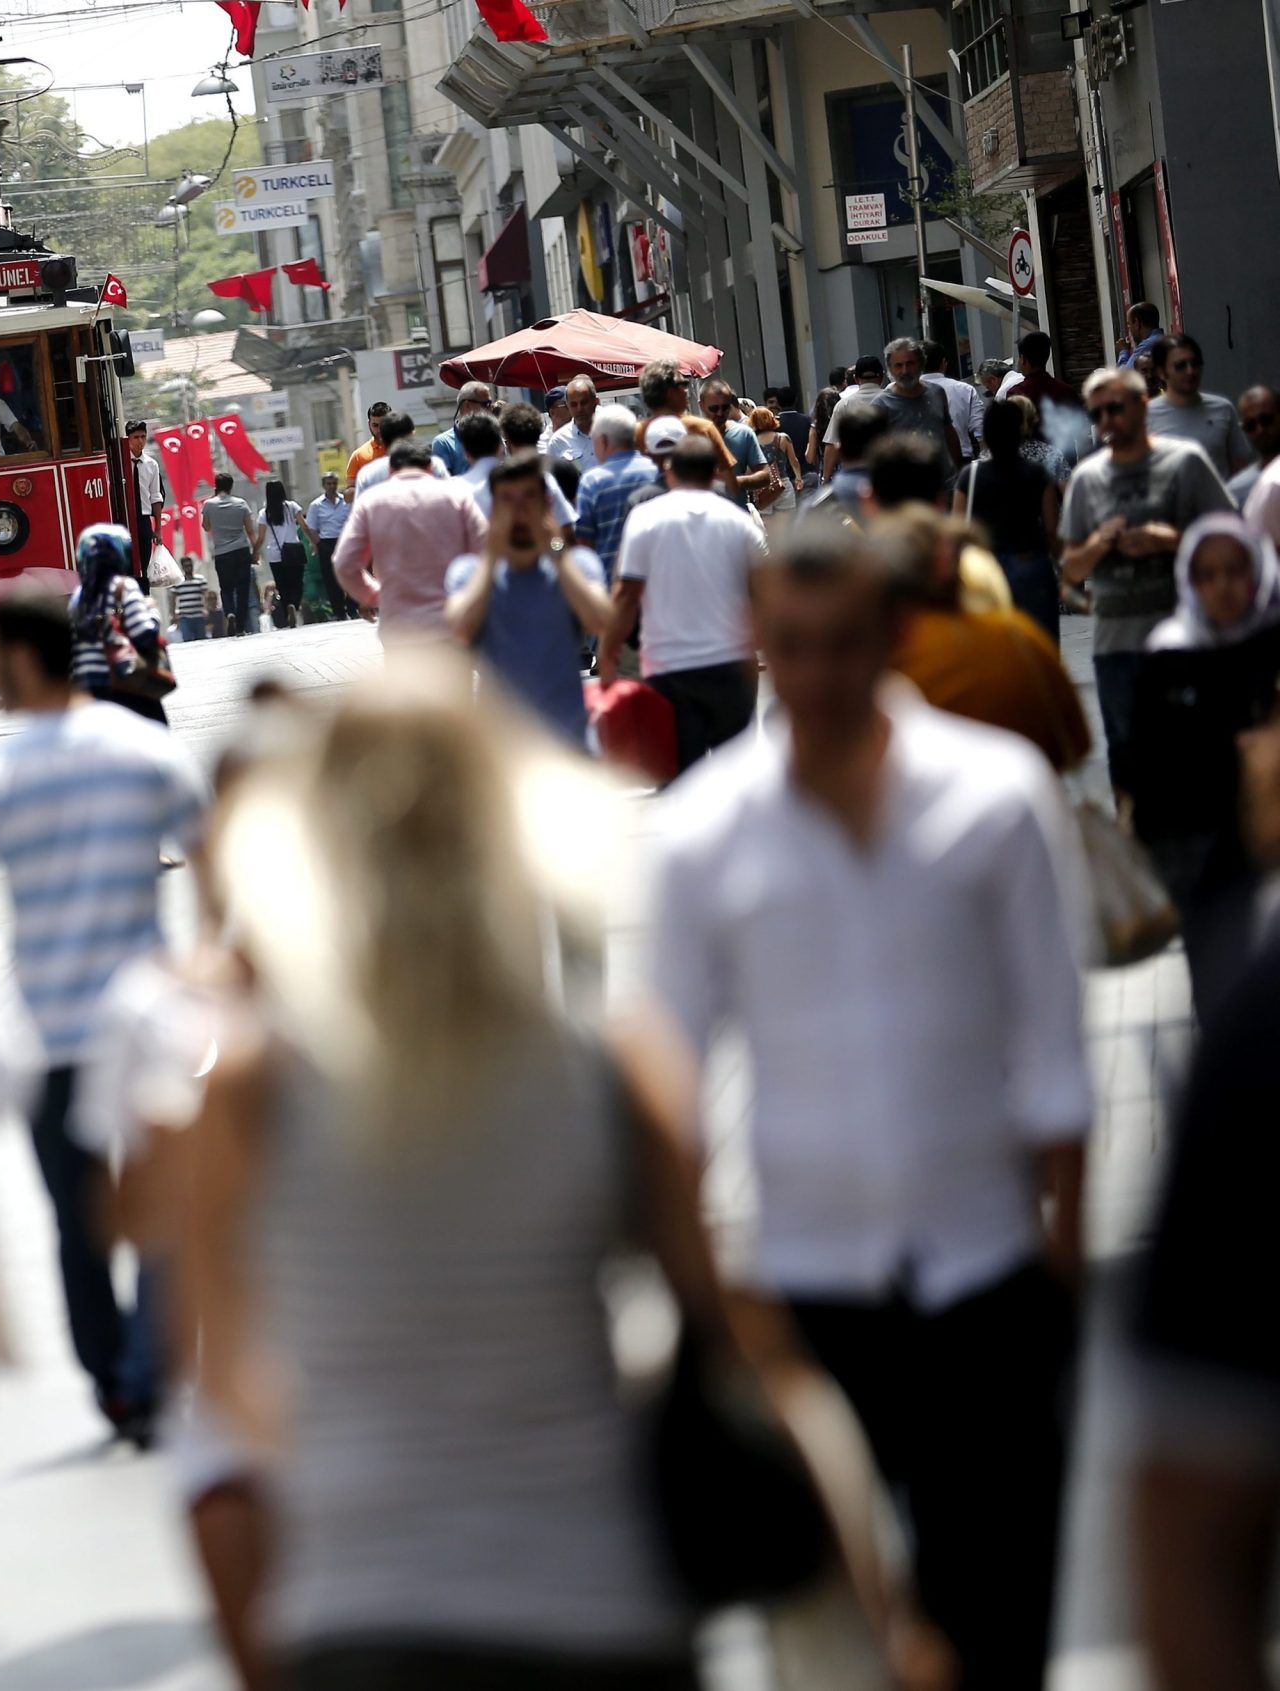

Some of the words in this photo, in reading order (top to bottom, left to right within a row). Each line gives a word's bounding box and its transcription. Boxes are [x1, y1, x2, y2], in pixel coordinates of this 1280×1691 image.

[262, 173, 333, 191] TURKCELL
[240, 204, 306, 222] TURKCELL
[848, 203, 883, 211] TRAMVAY
[849, 233, 887, 242] ODAKULE
[84, 478, 104, 498] 410
